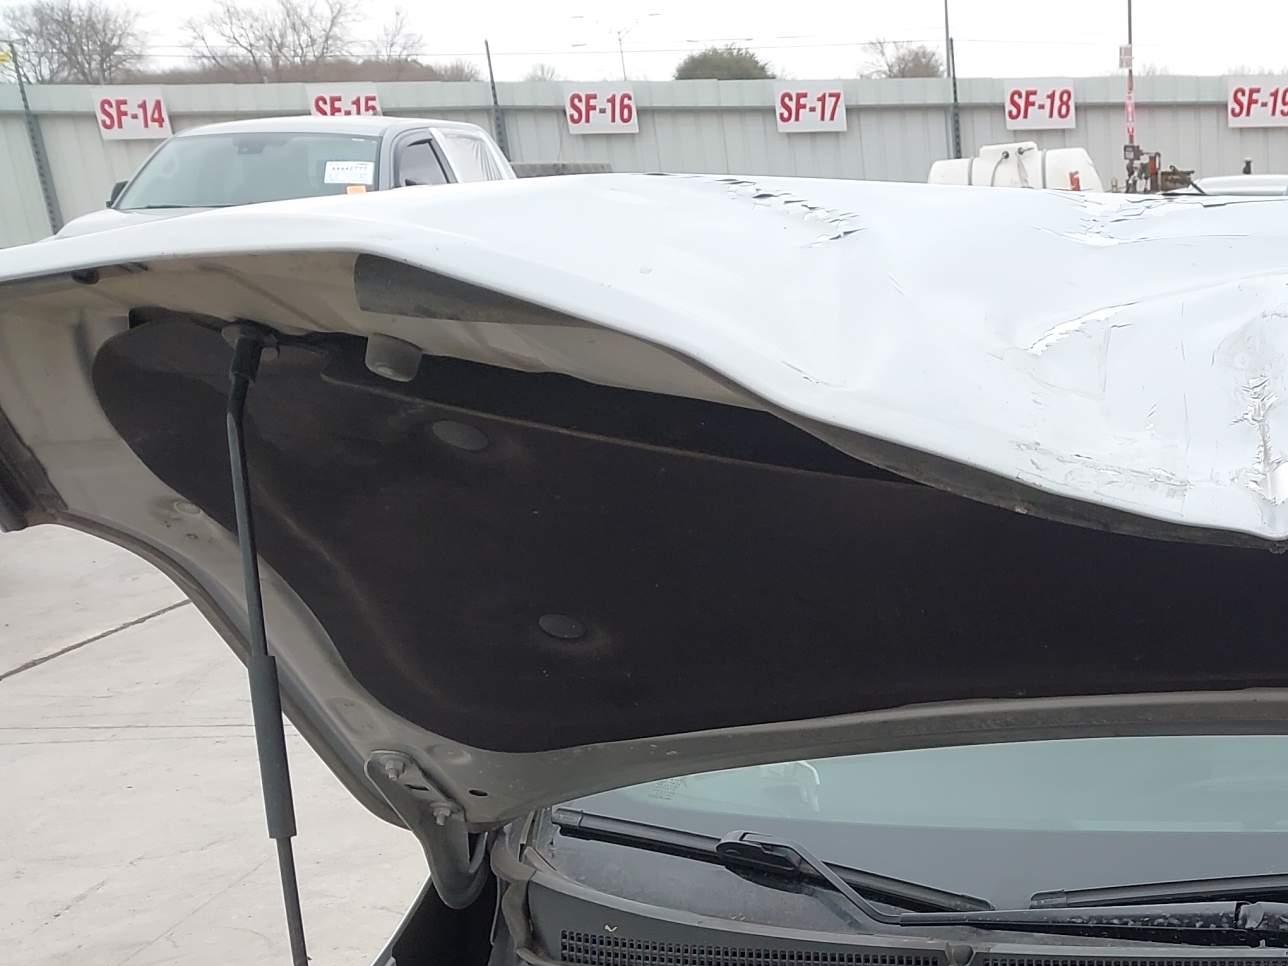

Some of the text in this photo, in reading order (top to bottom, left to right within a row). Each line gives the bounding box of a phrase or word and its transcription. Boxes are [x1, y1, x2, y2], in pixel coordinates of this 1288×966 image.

[100, 98, 165, 130] SF-14
[314, 95, 377, 116] SF-15
[569, 93, 633, 124] SF-16
[779, 92, 841, 123] SF-17
[1008, 89, 1072, 120] SF-18
